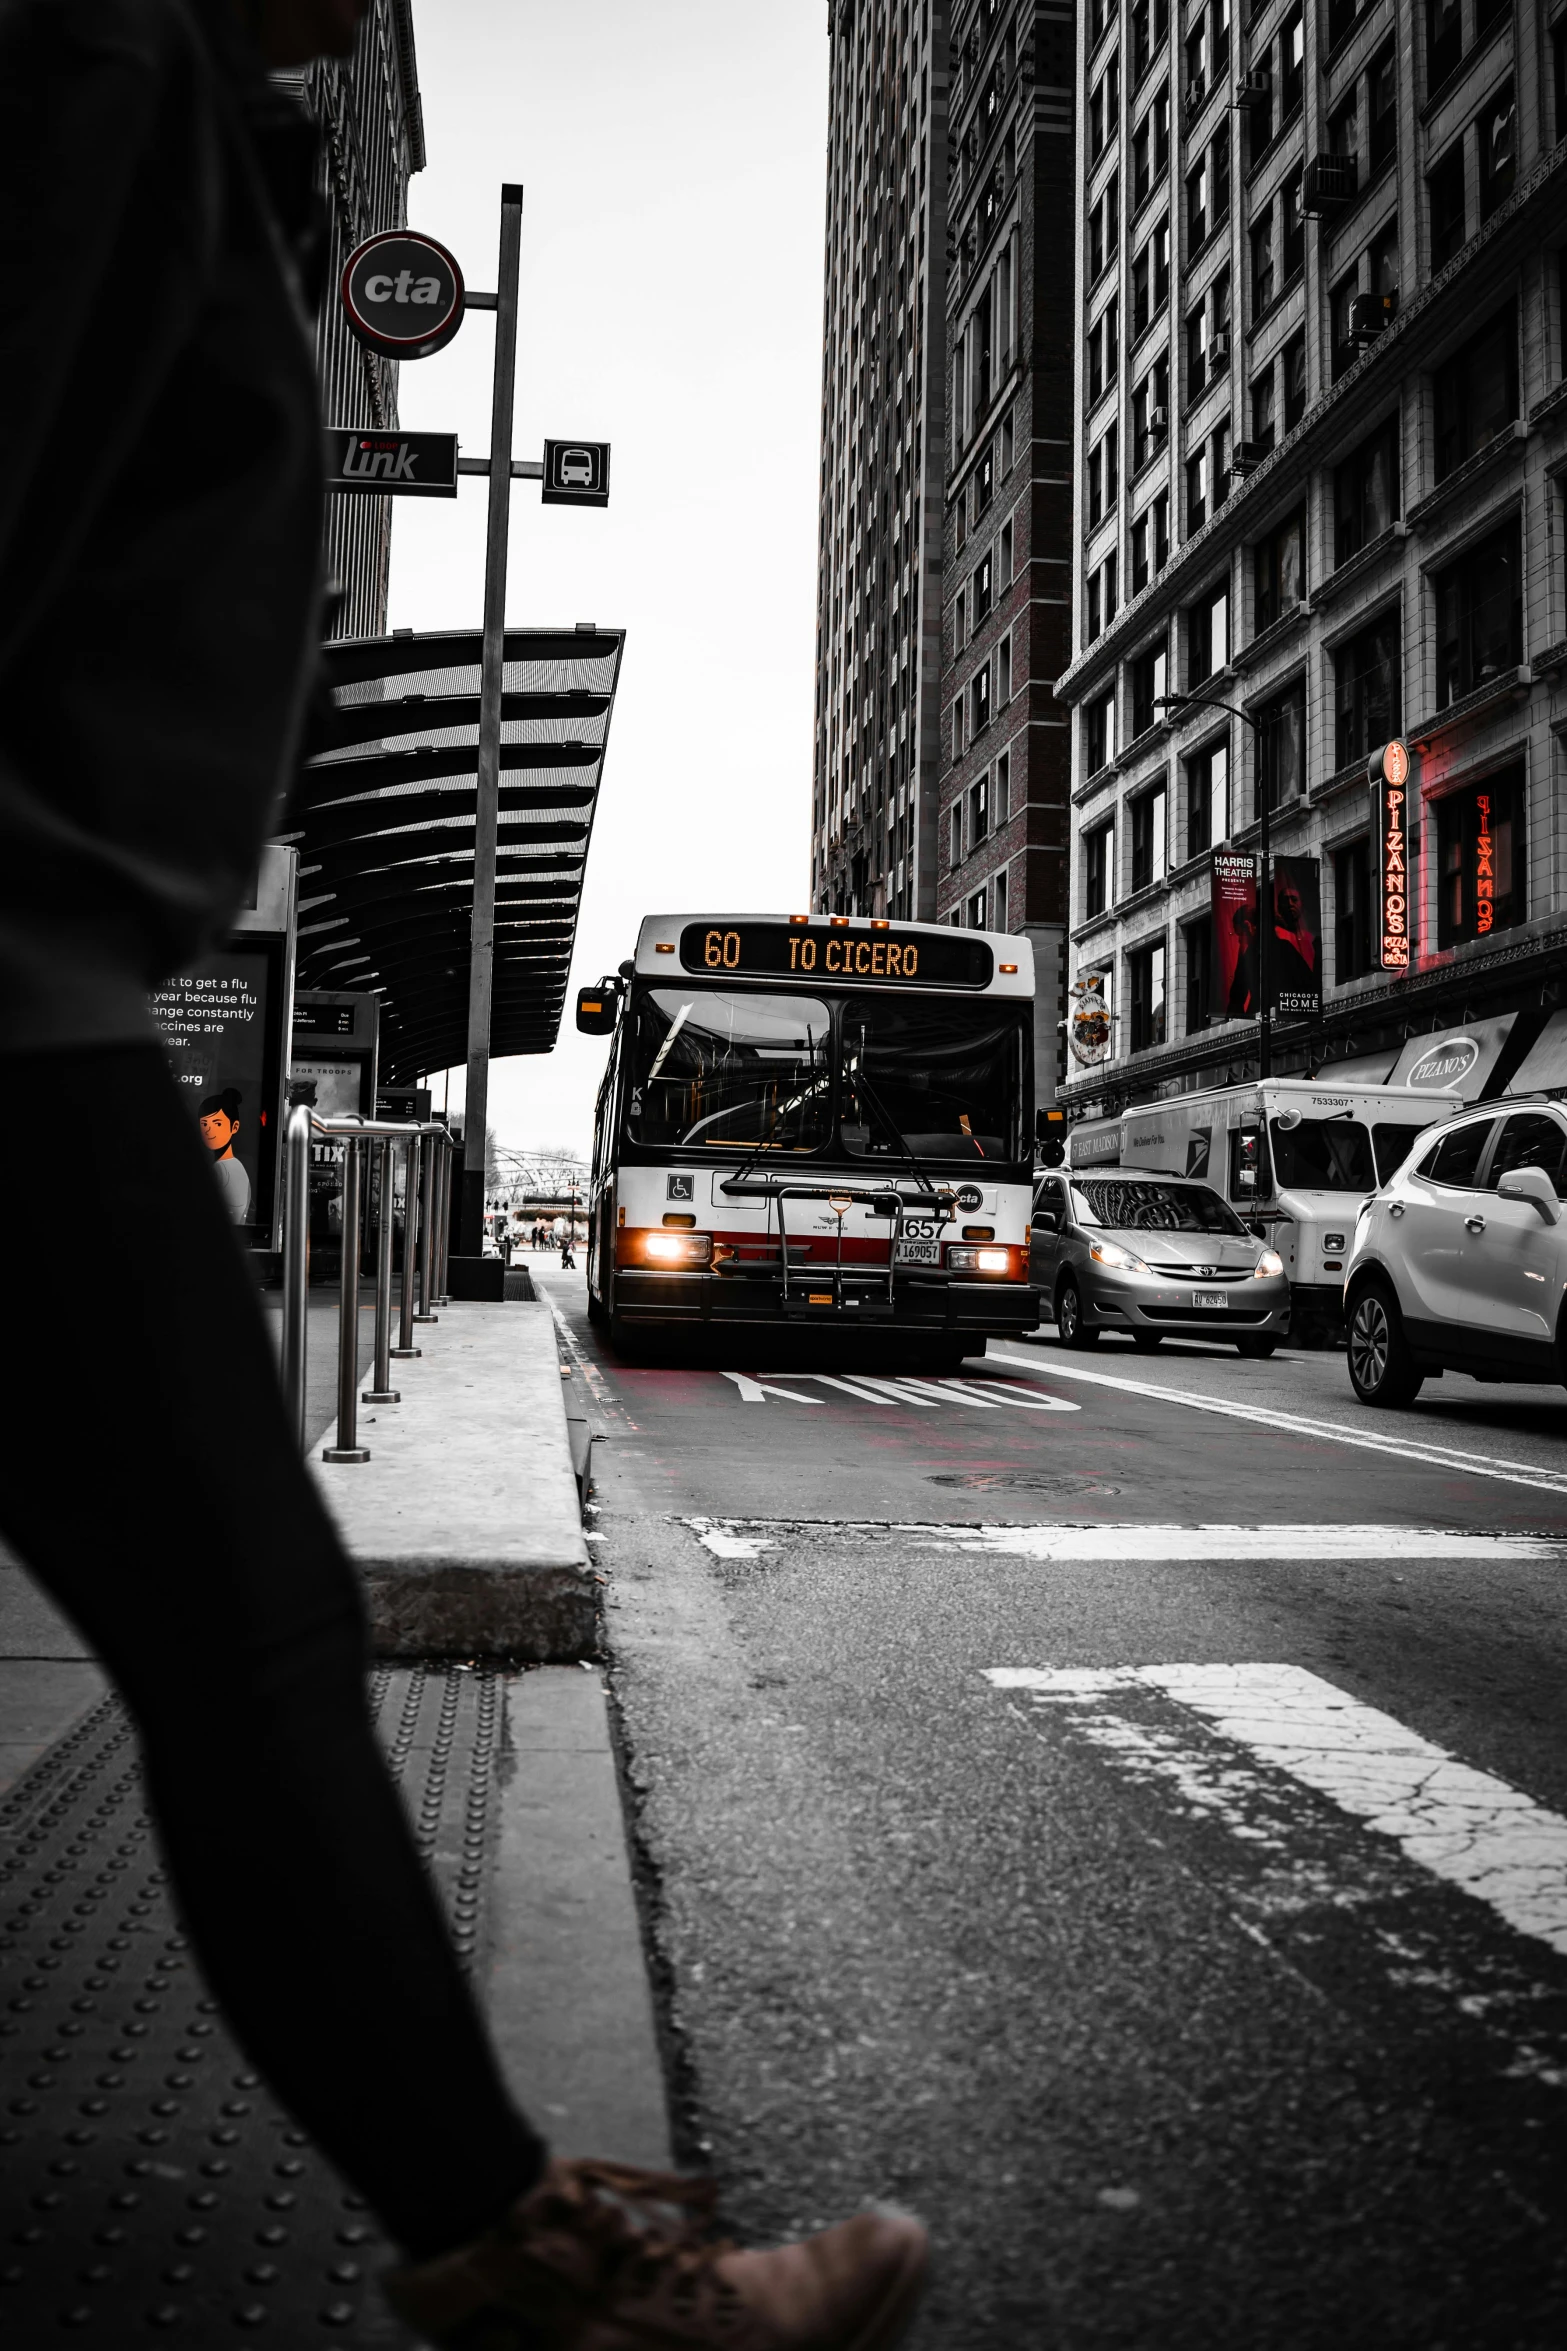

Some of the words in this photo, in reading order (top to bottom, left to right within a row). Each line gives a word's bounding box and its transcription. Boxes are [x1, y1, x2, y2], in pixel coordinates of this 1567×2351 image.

[365, 269, 441, 305] cta
[1214, 856, 1254, 868] HARRIS
[1386, 790, 1405, 934] PIZANO'S
[1214, 867, 1253, 878] THEATER
[704, 930, 741, 968] 60
[789, 937, 817, 970] TO
[825, 940, 918, 976] CICERO
[179, 977, 193, 987] to
[196, 978, 218, 990] get
[220, 980, 228, 988] a
[231, 978, 248, 990] flu
[153, 992, 182, 1003] year
[184, 991, 238, 1004] because
[240, 993, 257, 1005] flu
[1279, 998, 1319, 1010] HOME
[187, 1008, 255, 1022] constantly
[153, 1020, 201, 1032] accines
[203, 1024, 225, 1033] are
[317, 1068, 352, 1076] TROOPS
[1413, 1053, 1470, 1081] PIZANO'S
[631, 1086, 643, 1101] K
[1311, 1097, 1349, 1106] 7533307
[312, 1144, 345, 1162] TIX
[1078, 1139, 1092, 1157] EAST
[959, 1193, 979, 1204] cta
[903, 1245, 938, 1259] 169057
